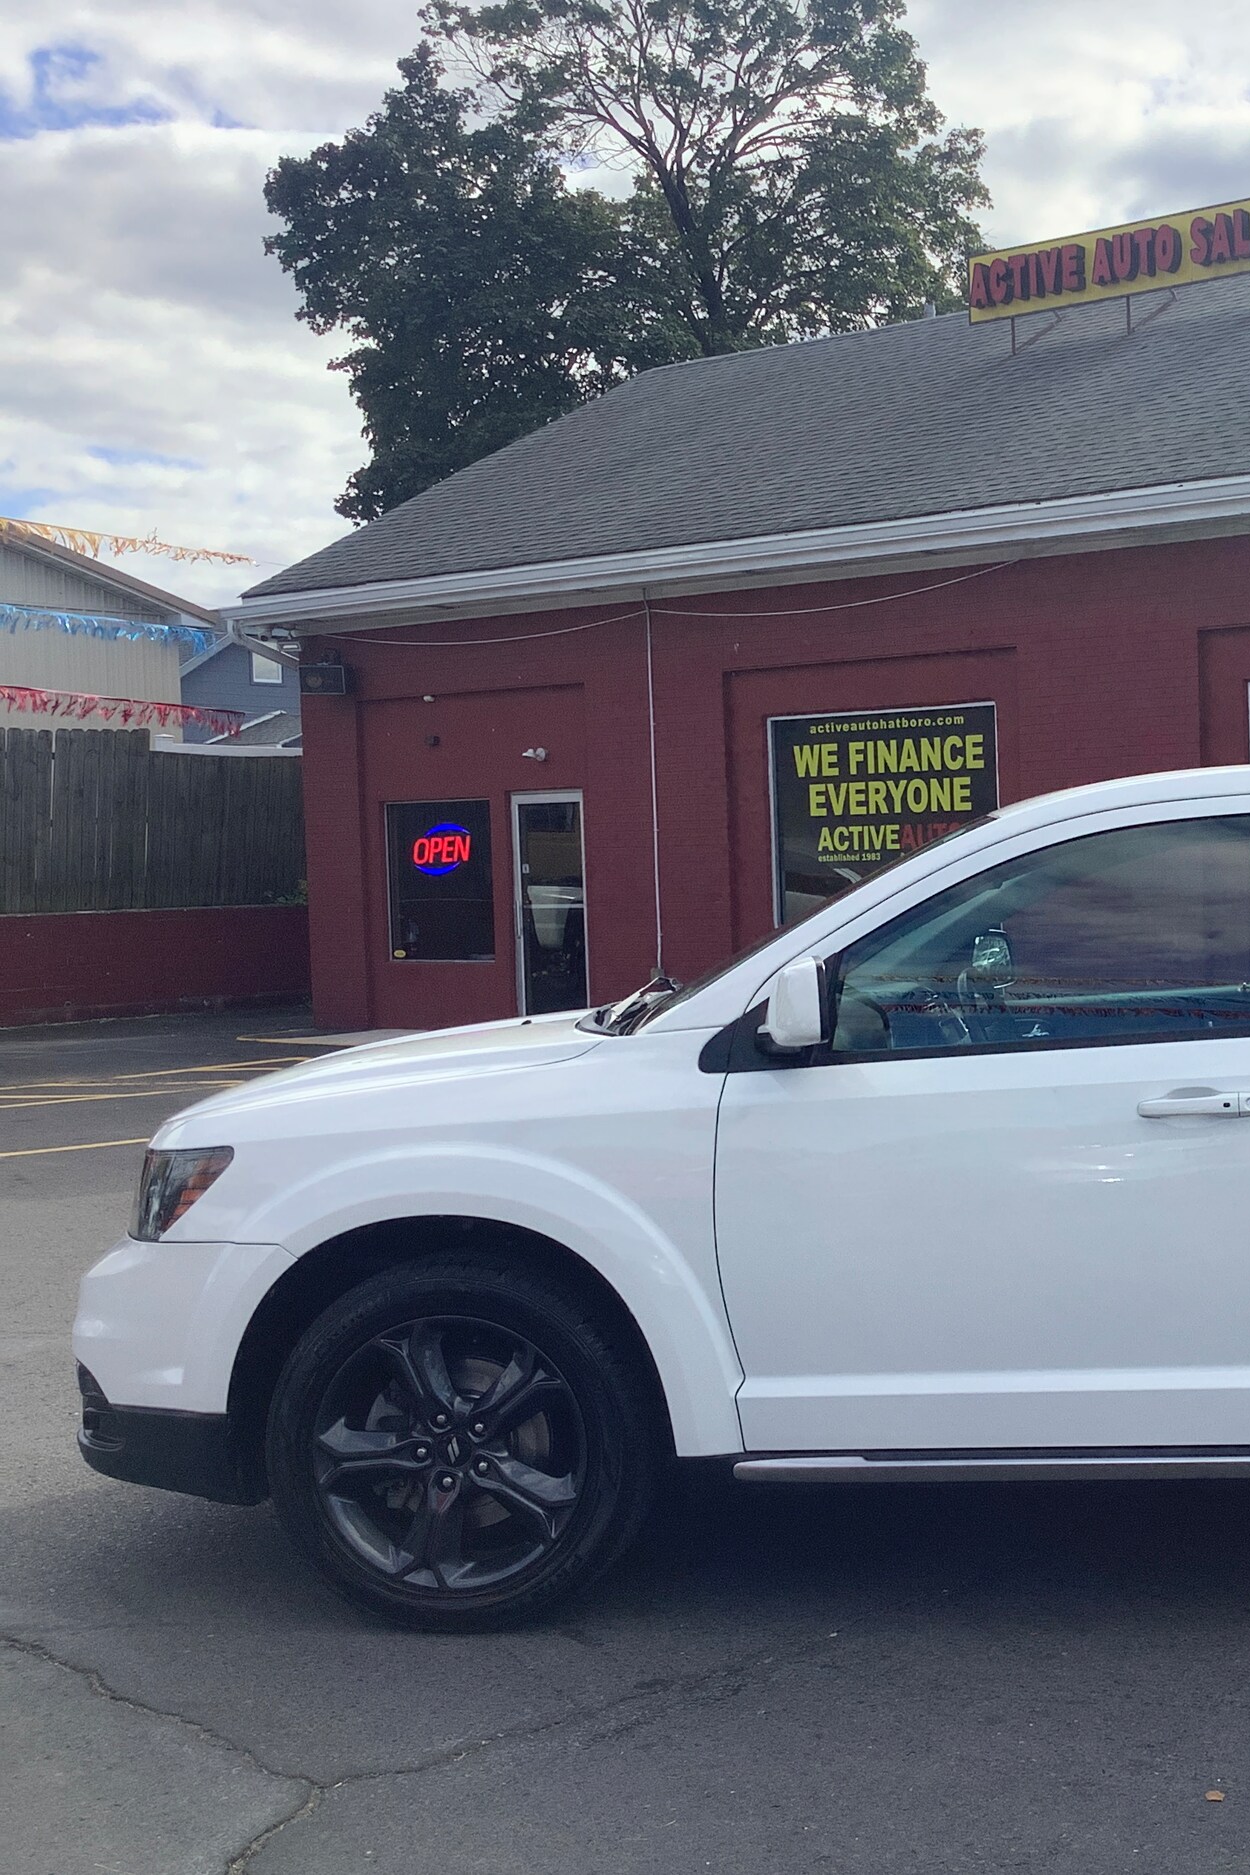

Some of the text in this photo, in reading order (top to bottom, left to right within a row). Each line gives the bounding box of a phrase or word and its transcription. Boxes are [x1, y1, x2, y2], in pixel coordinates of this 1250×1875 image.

[970, 244, 1086, 309] ACTIVE
[1092, 224, 1183, 287] AUTO
[809, 714, 965, 734] activeautohatboro.com
[793, 734, 985, 778] WE FINANCE
[808, 776, 973, 817] EVERYONE
[413, 834, 471, 865] OPEN
[818, 851, 881, 863] established 1983
